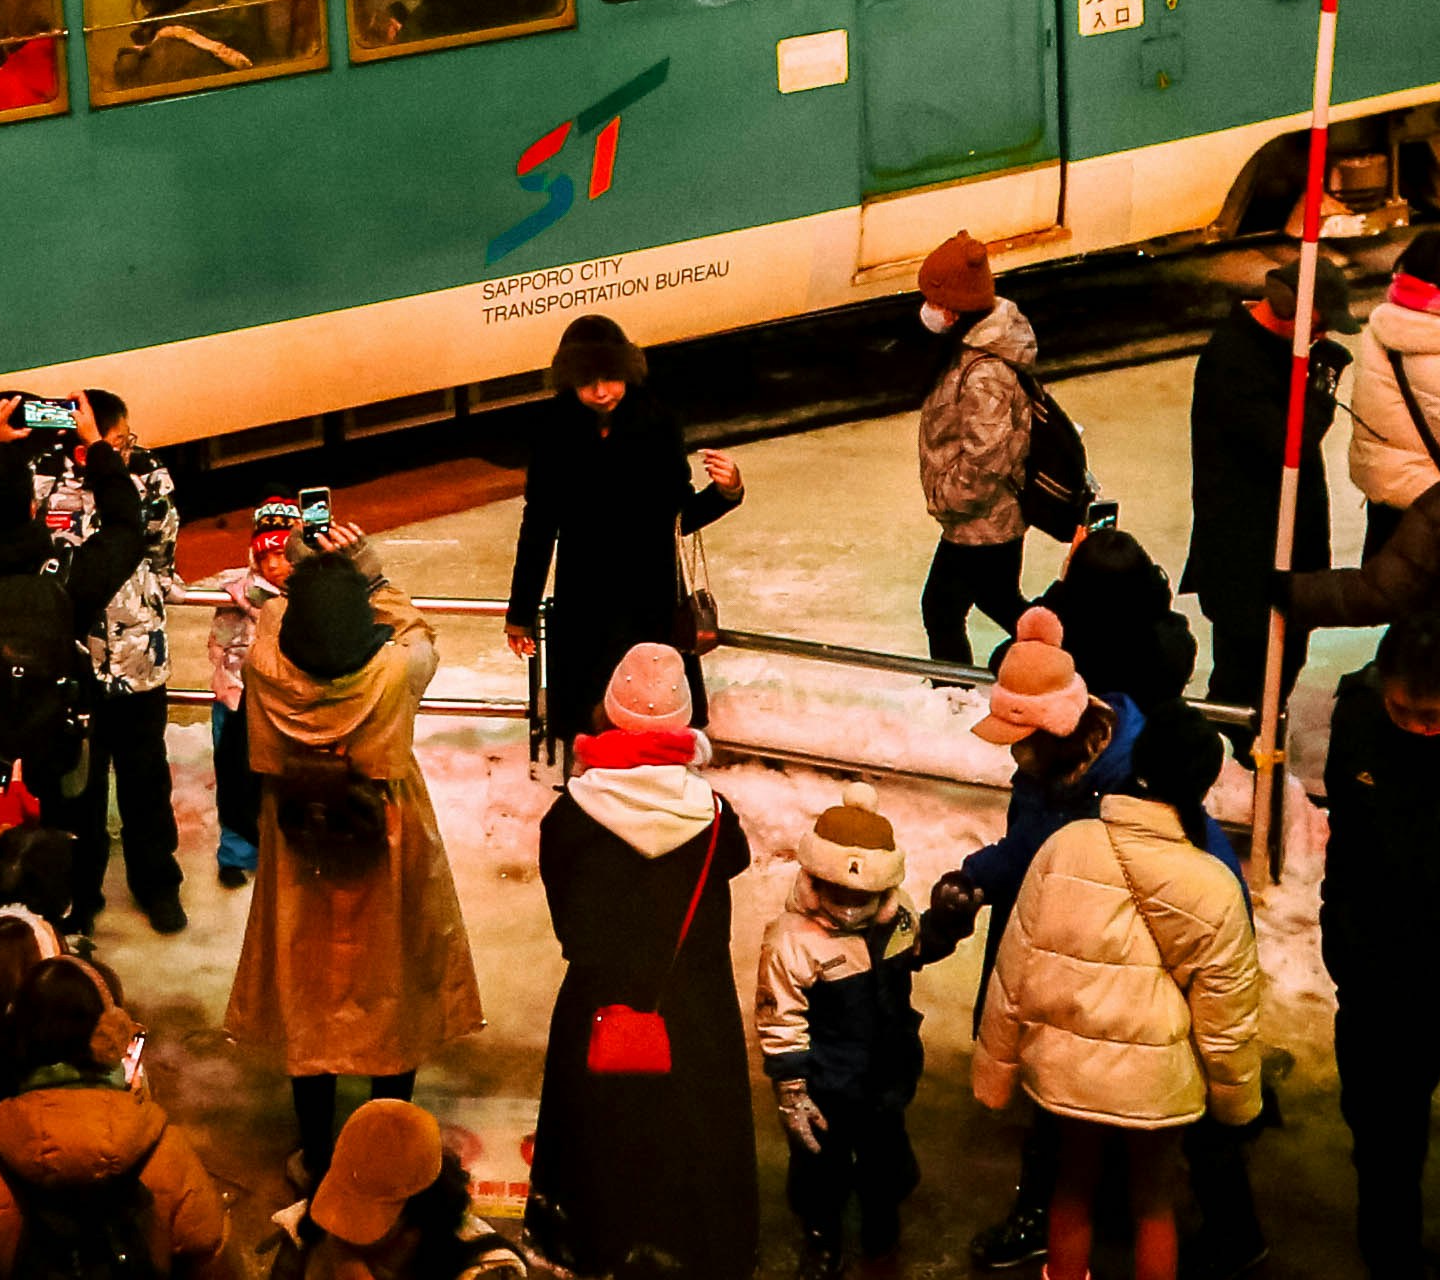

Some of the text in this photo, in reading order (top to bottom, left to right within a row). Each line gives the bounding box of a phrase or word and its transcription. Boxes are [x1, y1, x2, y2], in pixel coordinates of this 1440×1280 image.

[1093, 7, 1131, 29] 入口
[481, 257, 624, 301] SAPPORO CITY
[482, 259, 732, 326] TRANSPORTATION BUREAU
